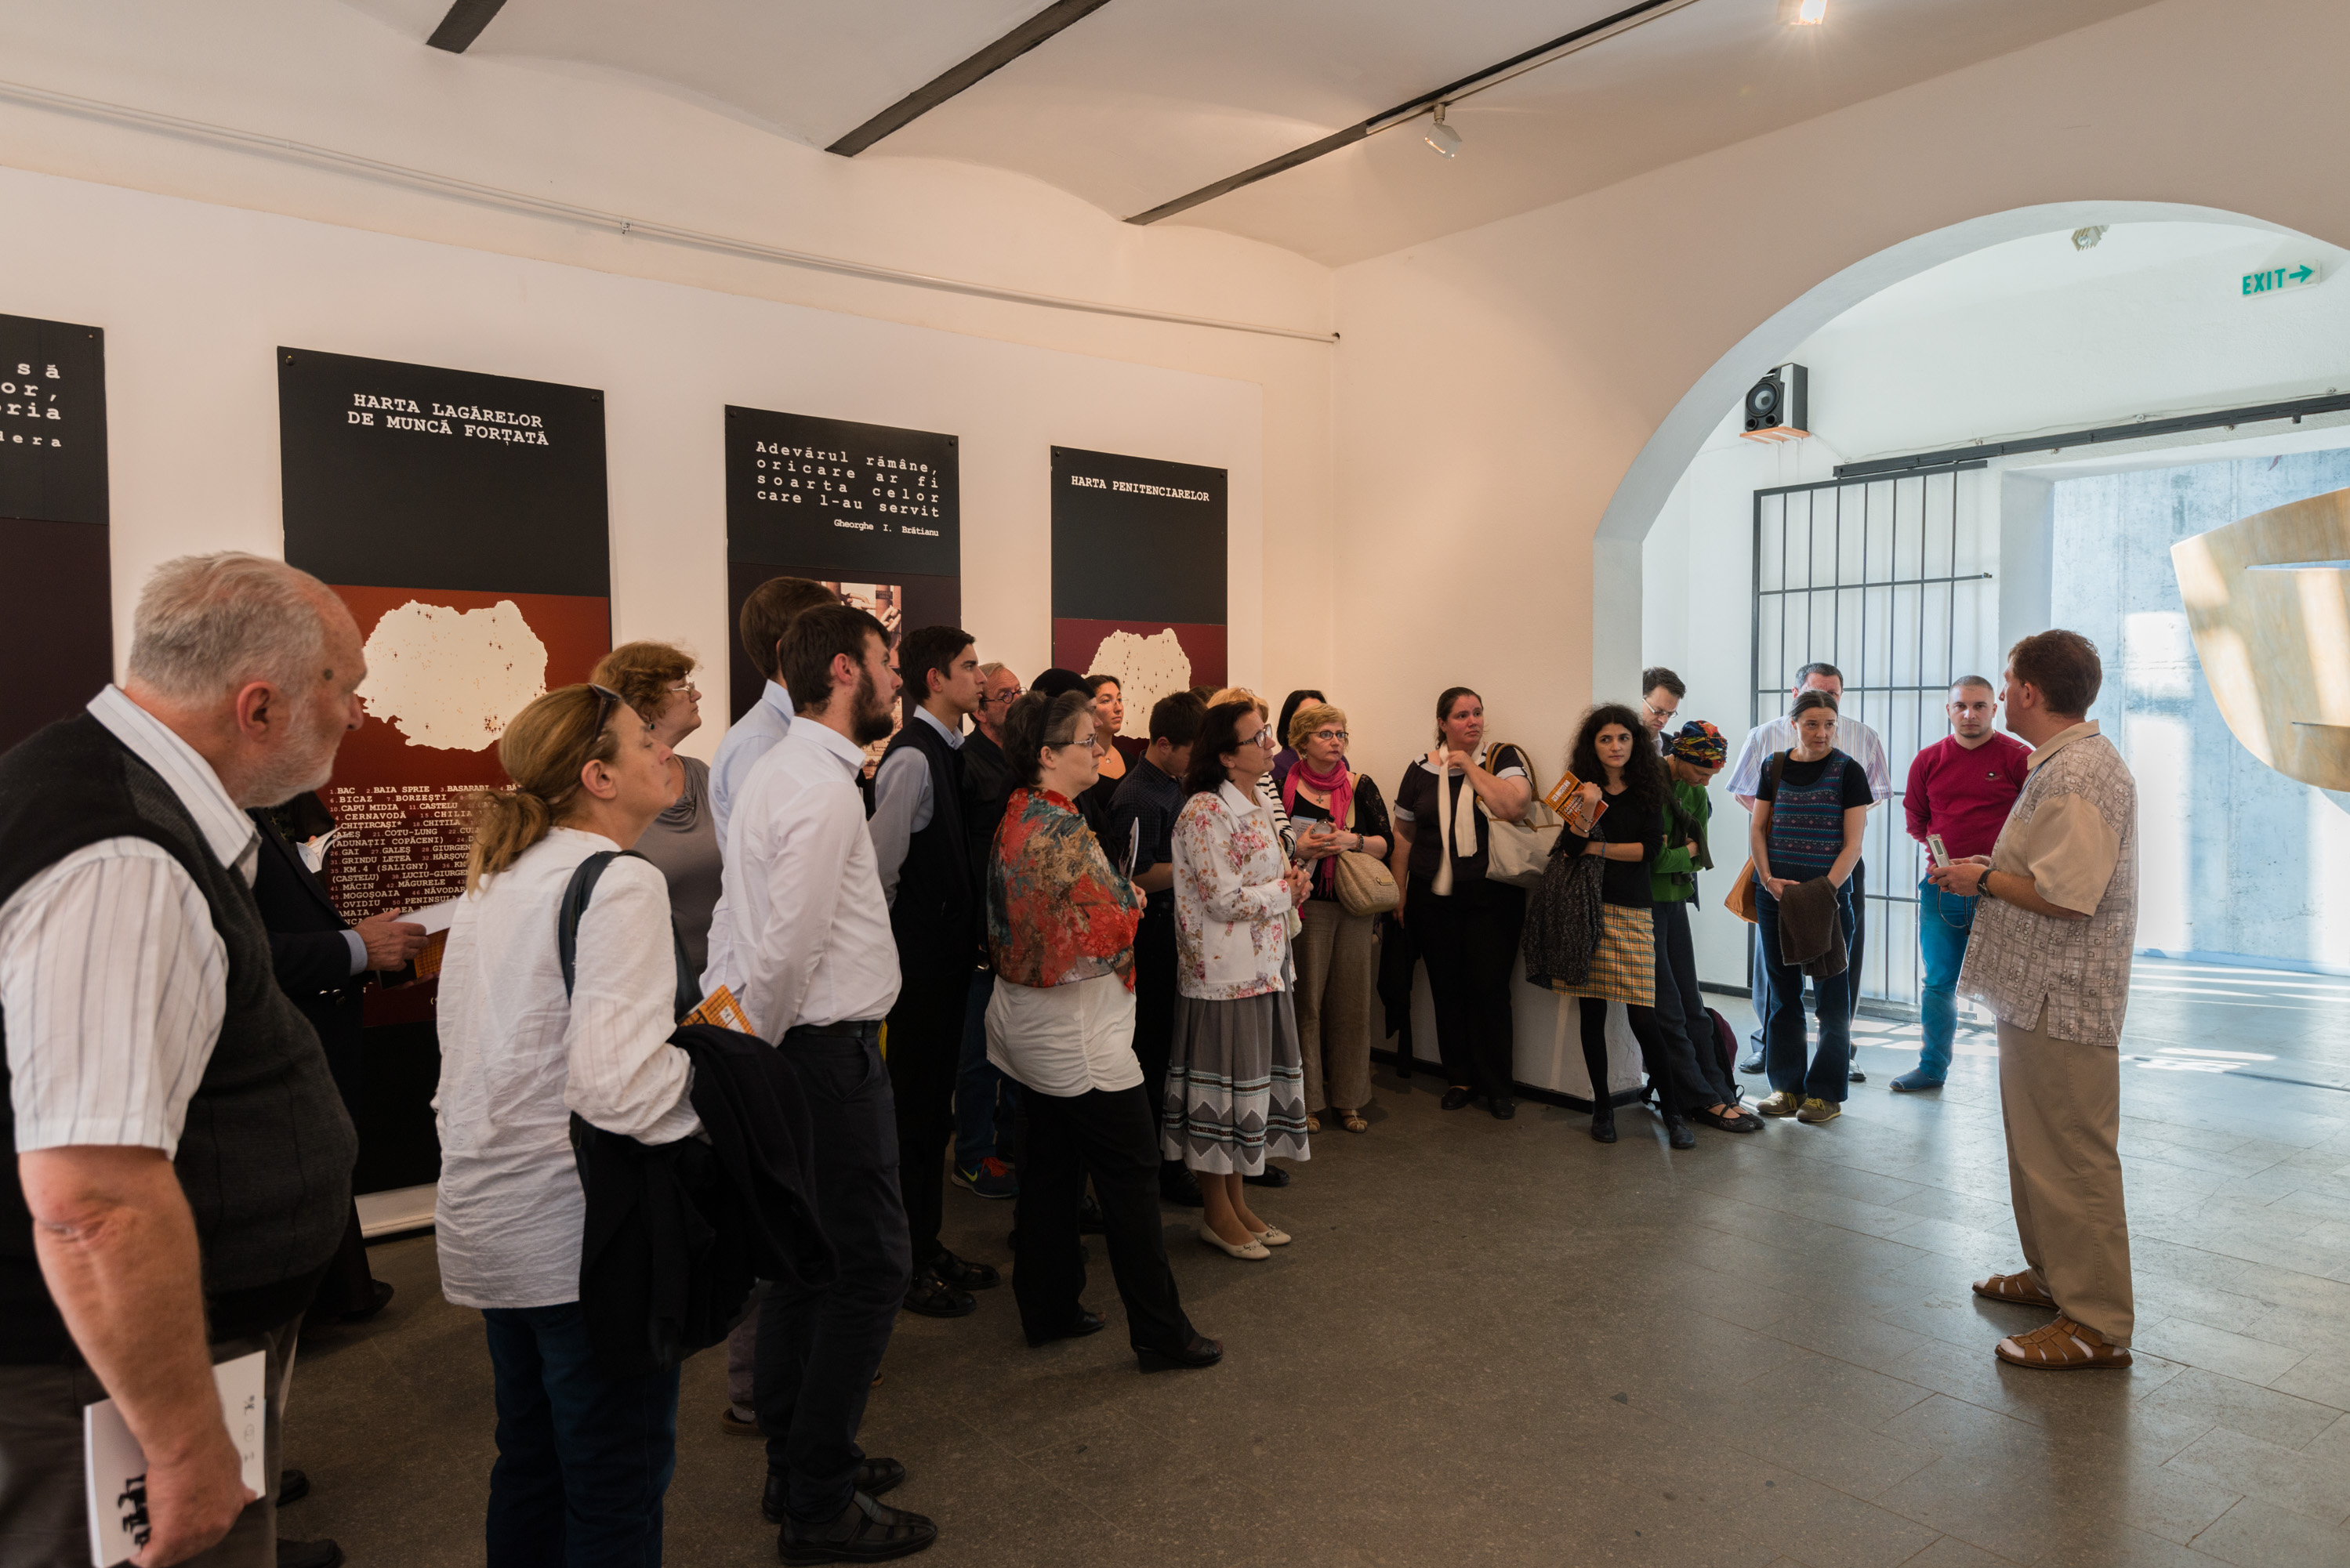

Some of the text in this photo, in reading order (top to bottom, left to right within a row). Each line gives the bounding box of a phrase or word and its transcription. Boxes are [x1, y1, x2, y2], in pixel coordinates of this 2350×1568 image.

[2243, 268, 2286, 295] EXIT
[0, 382, 57, 402] or,
[0, 402, 61, 420] ria
[347, 411, 375, 426] DE
[386, 415, 453, 435] MUNCĂ
[354, 393, 543, 429] HARTA LAGĂRELOR
[756, 441, 937, 476] Adevărul rămâne,
[756, 459, 939, 489] oricare ar fi
[756, 474, 940, 503] soarta celor
[1071, 475, 1210, 502] HARTA PENITENCIARELOR
[756, 491, 940, 518] care l-au servit
[833, 519, 940, 537] Gheorghe I. Brătianu
[332, 874, 379, 884] (CASTELU)
[377, 862, 429, 872] (SALIGNY)
